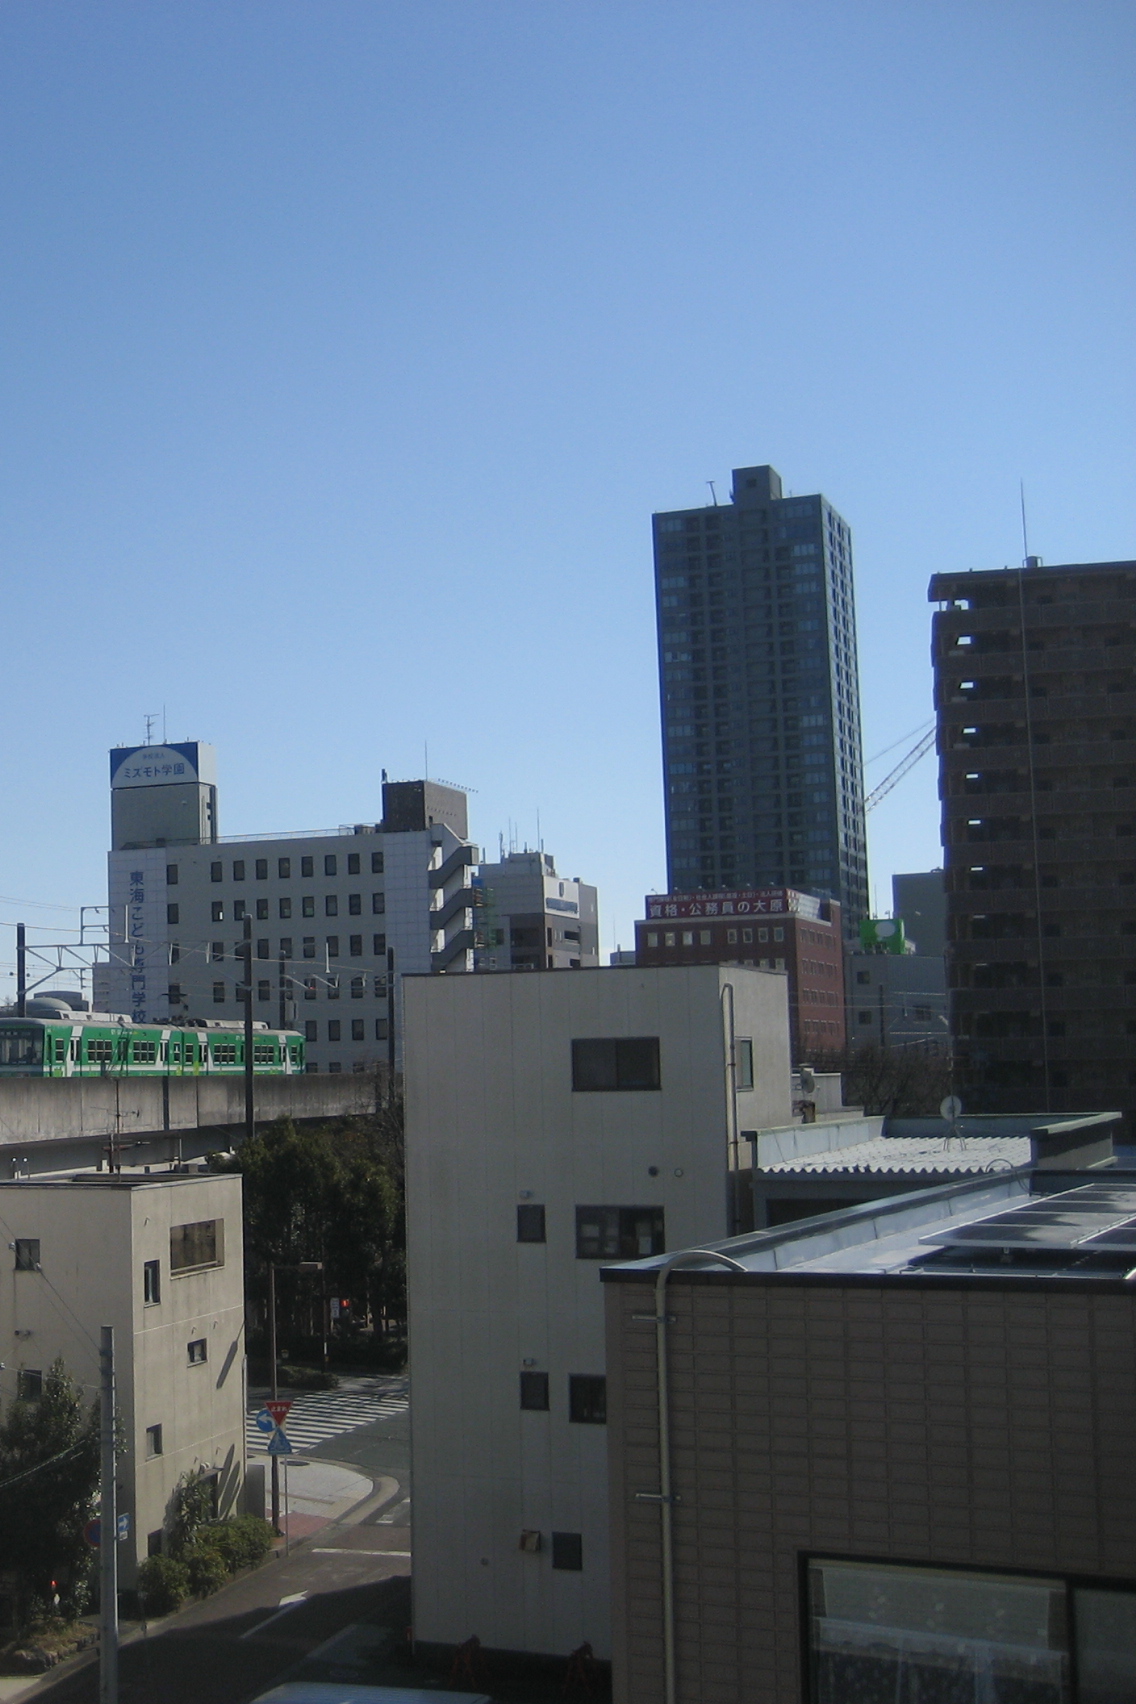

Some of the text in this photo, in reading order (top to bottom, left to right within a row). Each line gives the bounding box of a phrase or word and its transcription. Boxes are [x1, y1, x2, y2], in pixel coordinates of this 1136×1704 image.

[124, 763, 185, 779] ミズモト学園
[649, 899, 783, 918] 資格・公務員の大原
